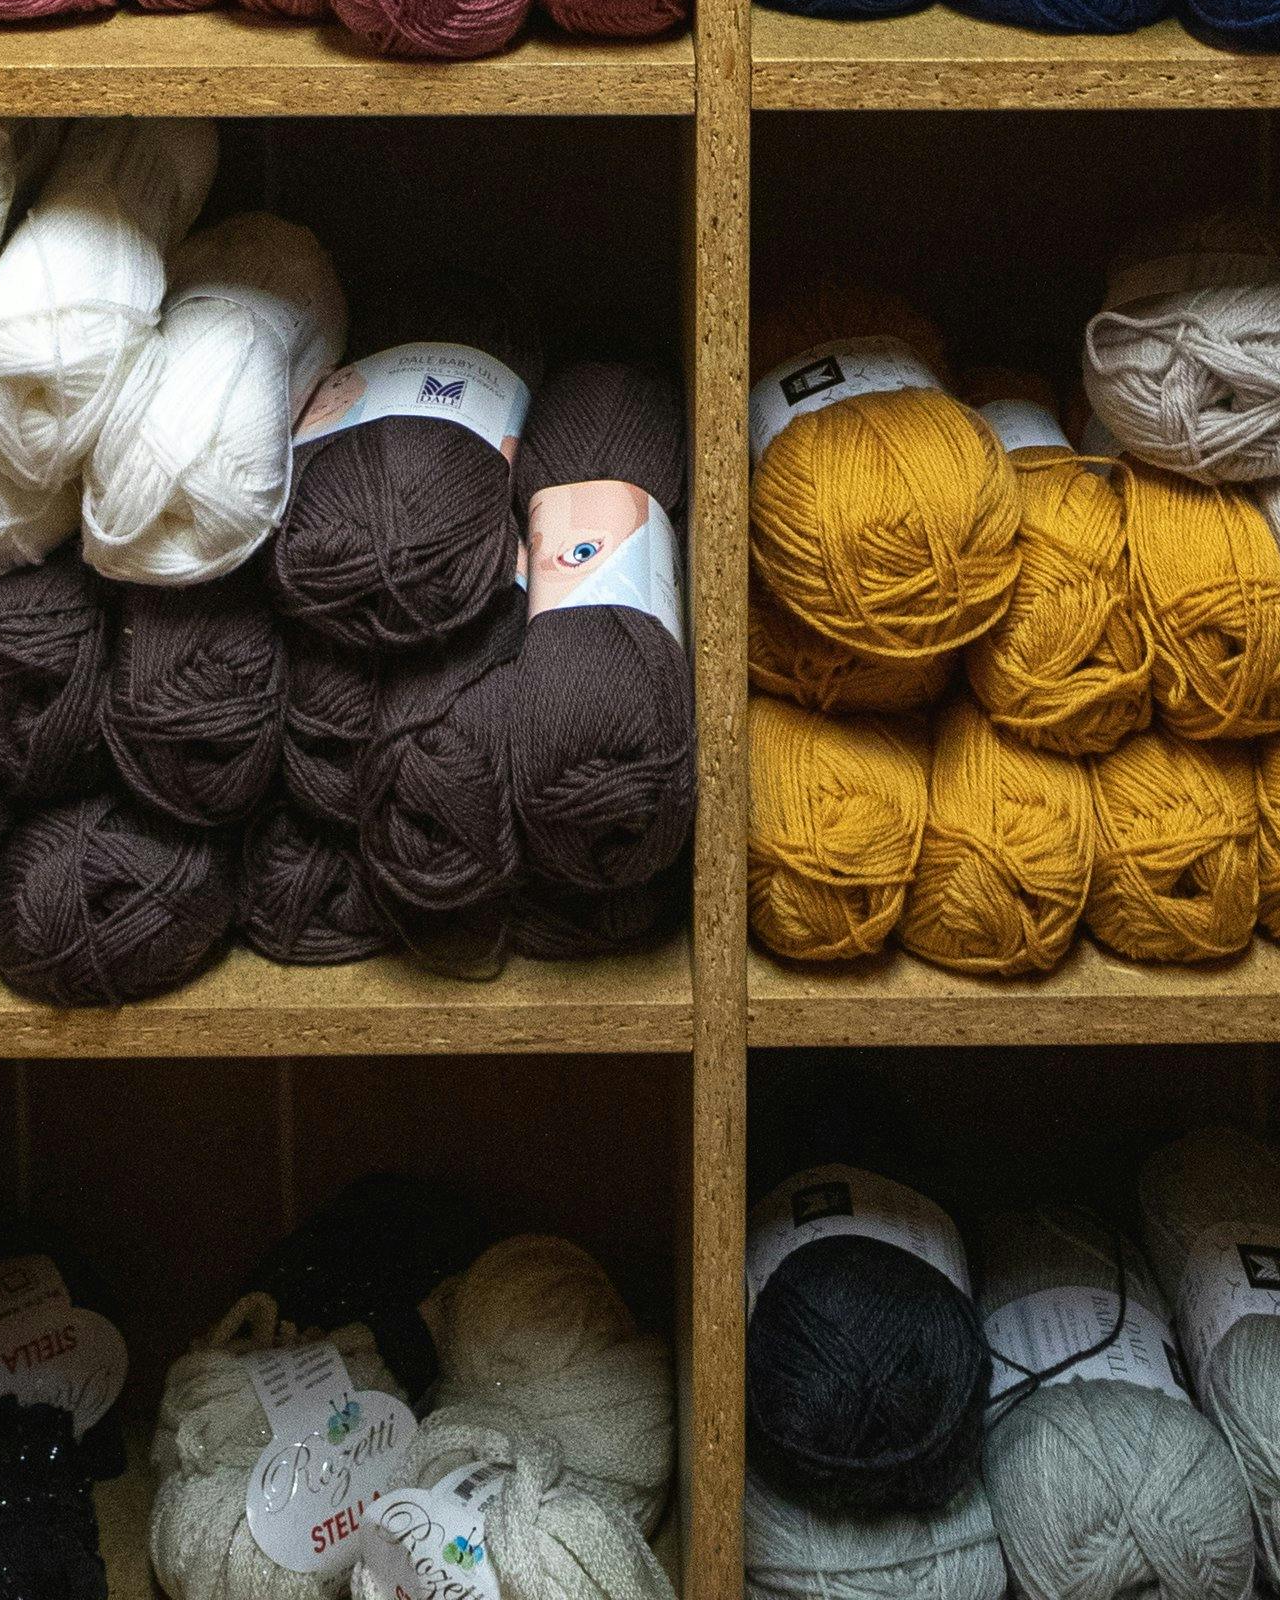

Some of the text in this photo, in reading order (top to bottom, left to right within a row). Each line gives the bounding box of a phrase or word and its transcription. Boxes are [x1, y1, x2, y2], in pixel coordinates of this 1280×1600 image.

[438, 357, 475, 370] BABY
[419, 395, 462, 406] DALE
[0, 1325, 77, 1374] STELLA
[261, 1413, 396, 1515] Rozetti
